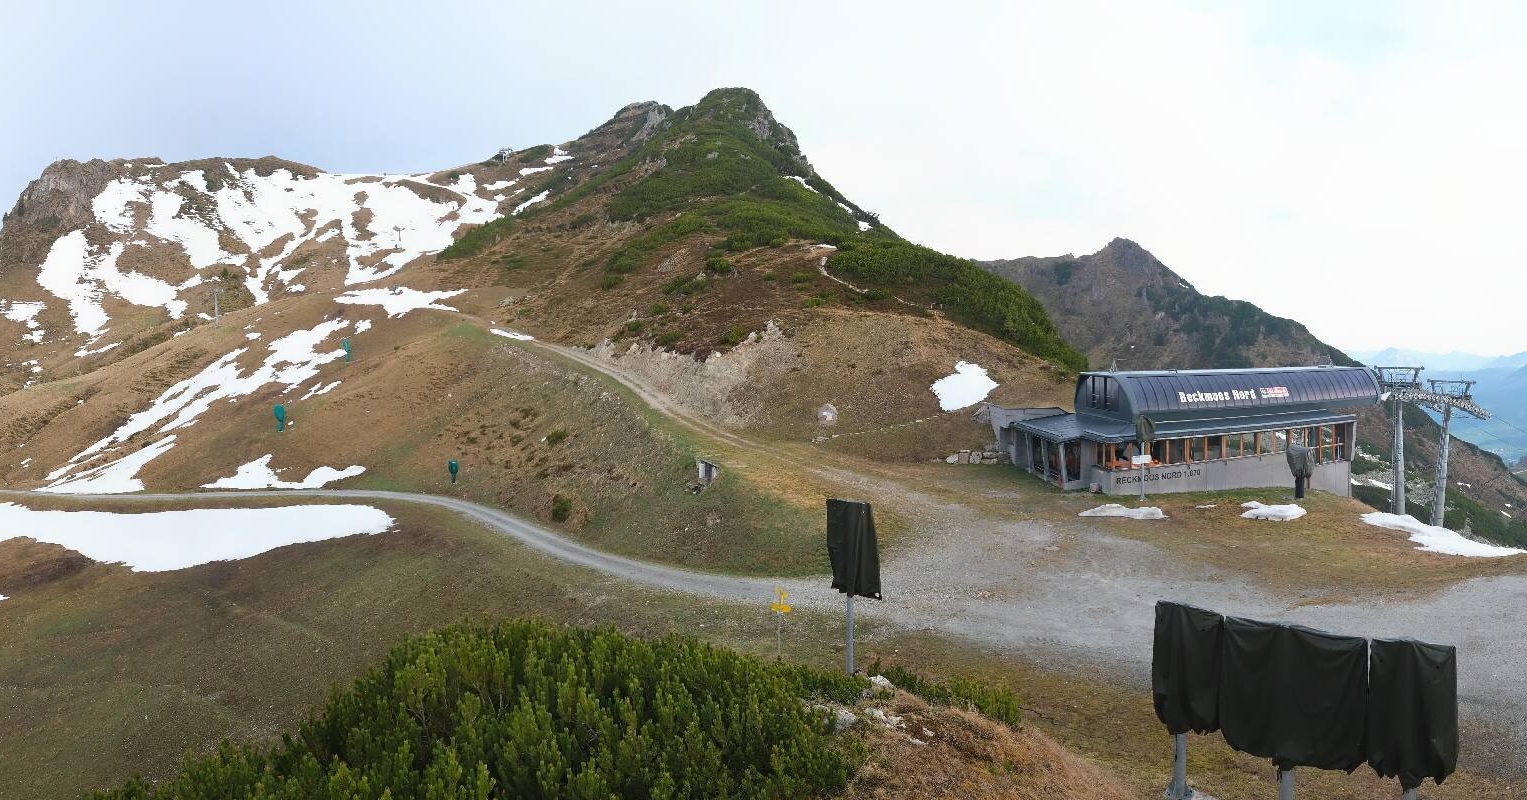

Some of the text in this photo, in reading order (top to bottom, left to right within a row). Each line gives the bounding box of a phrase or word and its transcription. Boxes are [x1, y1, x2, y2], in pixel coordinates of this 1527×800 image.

[1178, 391, 1230, 403] Reckmoos
[1232, 388, 1256, 400] Nord
[1161, 471, 1182, 480] NORD
